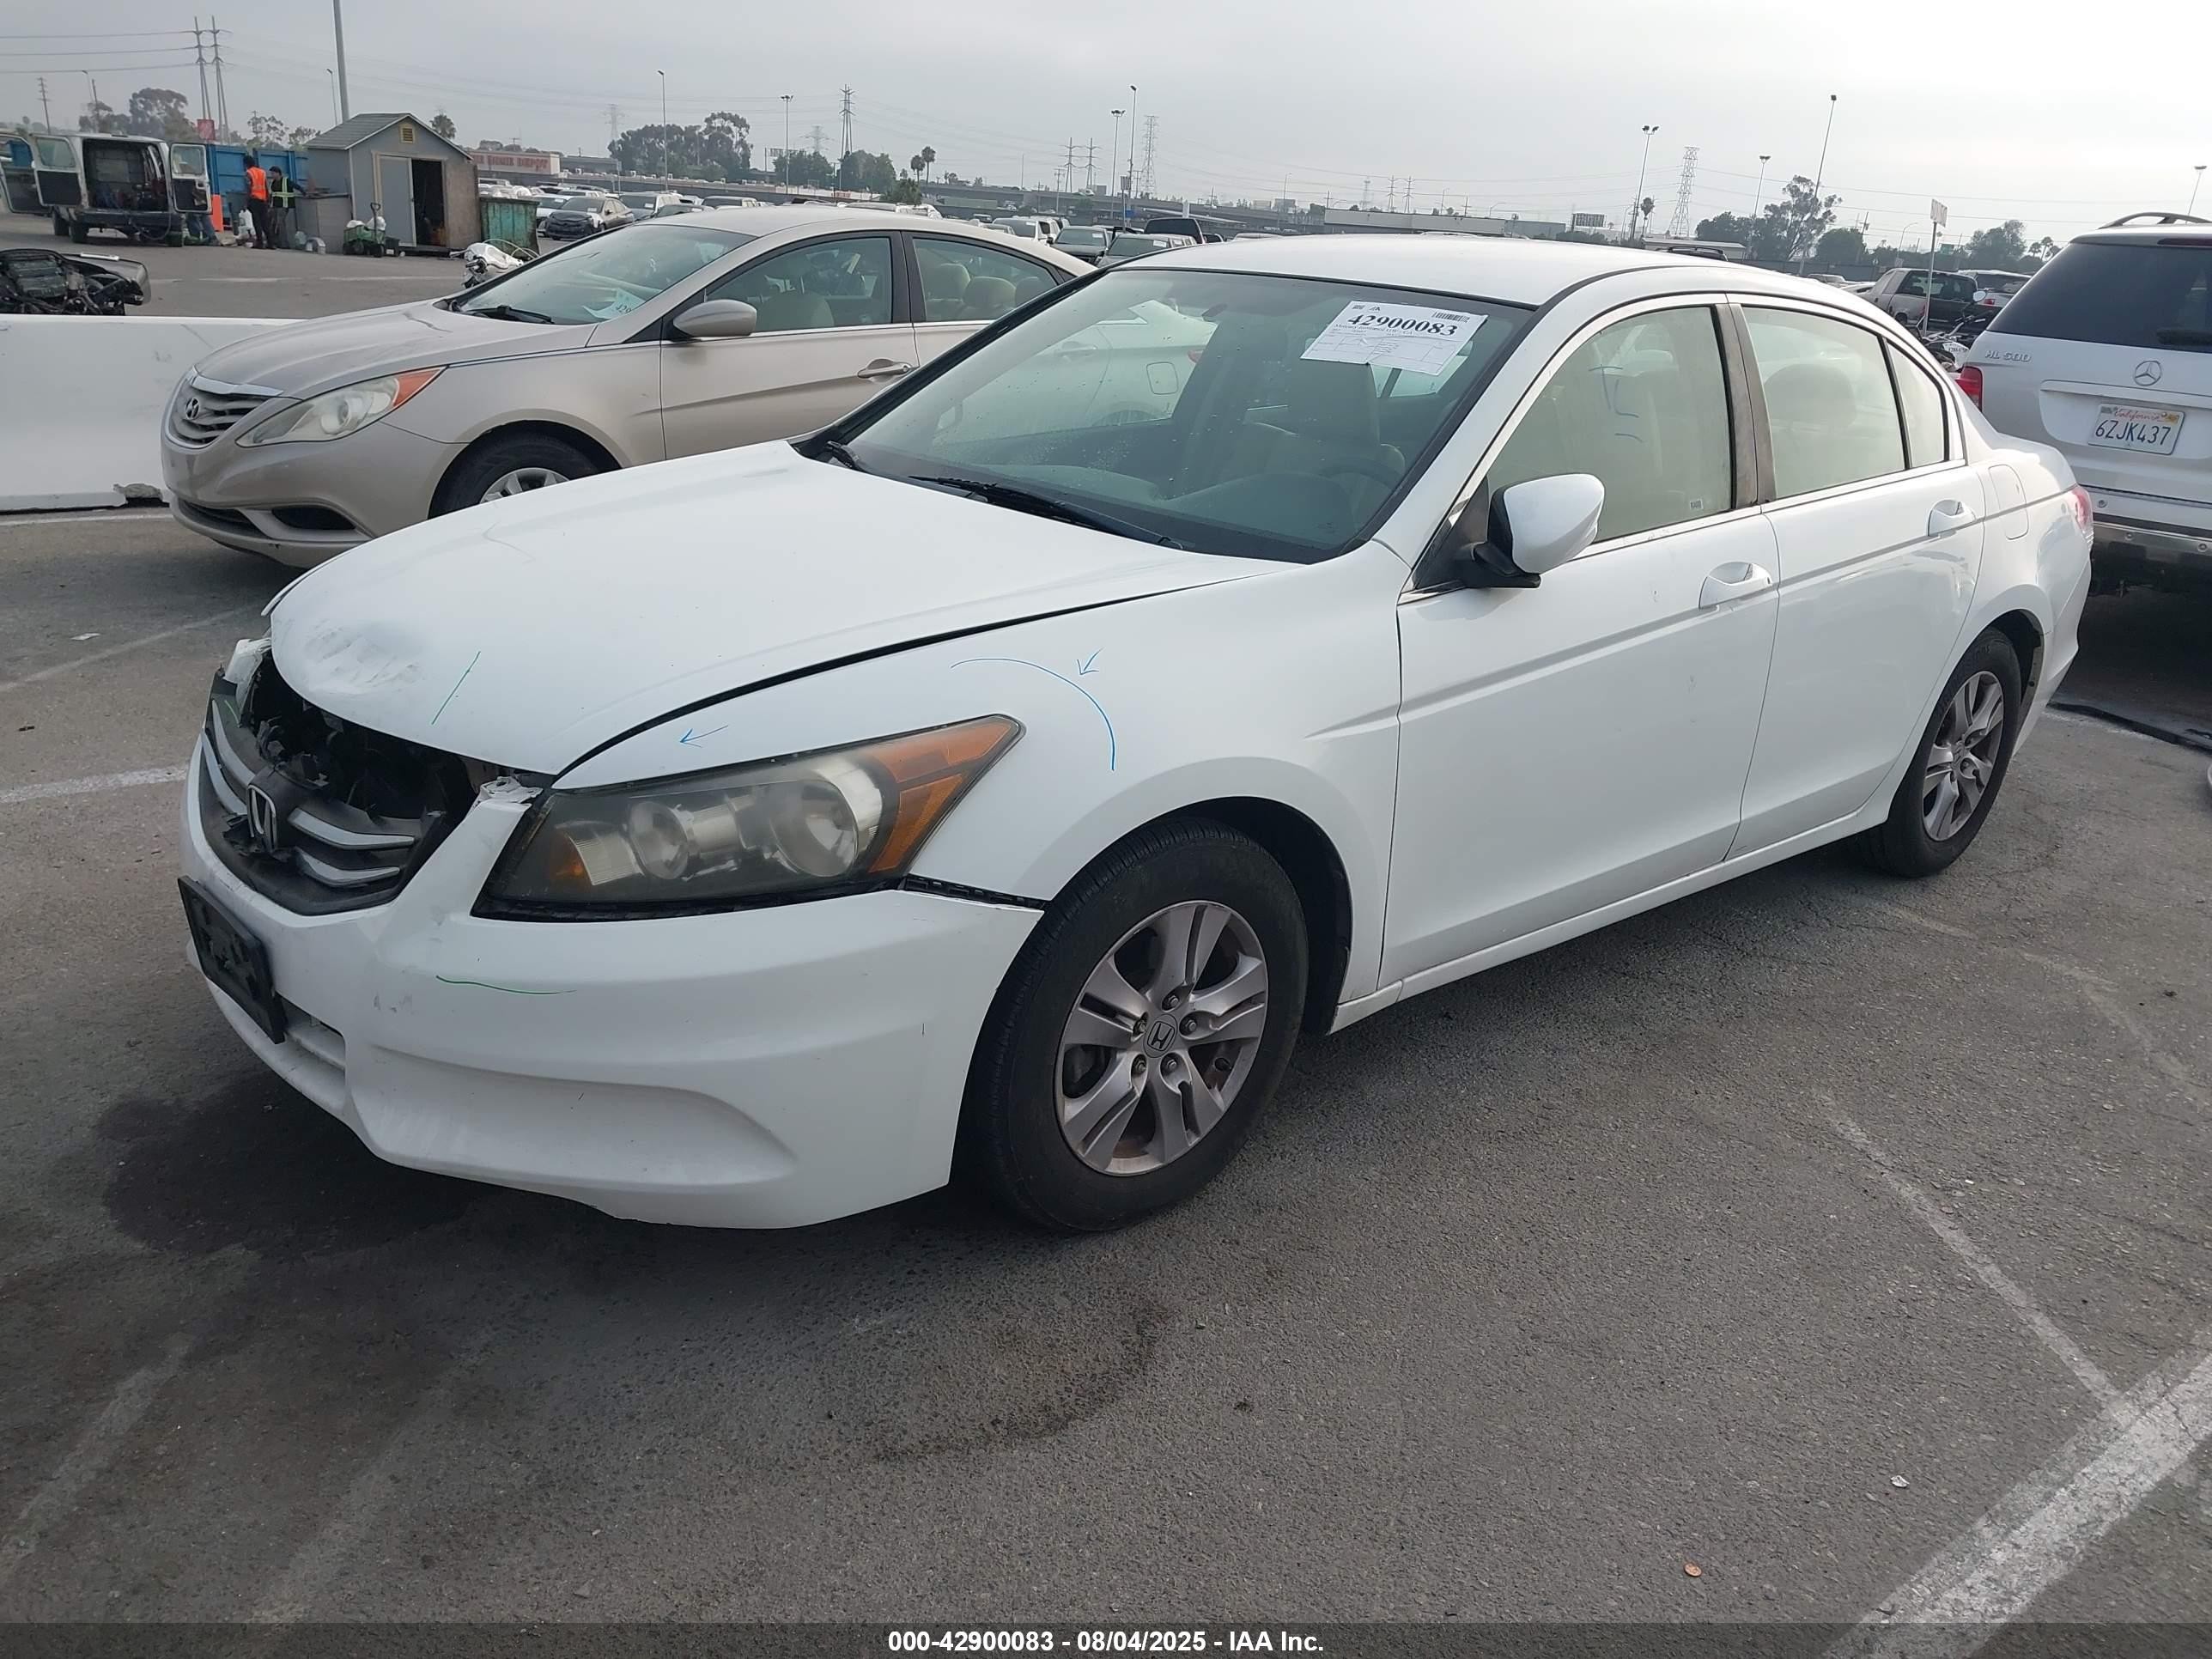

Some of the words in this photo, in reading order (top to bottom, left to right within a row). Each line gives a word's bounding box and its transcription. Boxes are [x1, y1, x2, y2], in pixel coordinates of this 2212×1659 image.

[1348, 314, 1458, 336] 42900083
[2114, 407, 2160, 422] California
[2095, 419, 2171, 446] 6ZJK437
